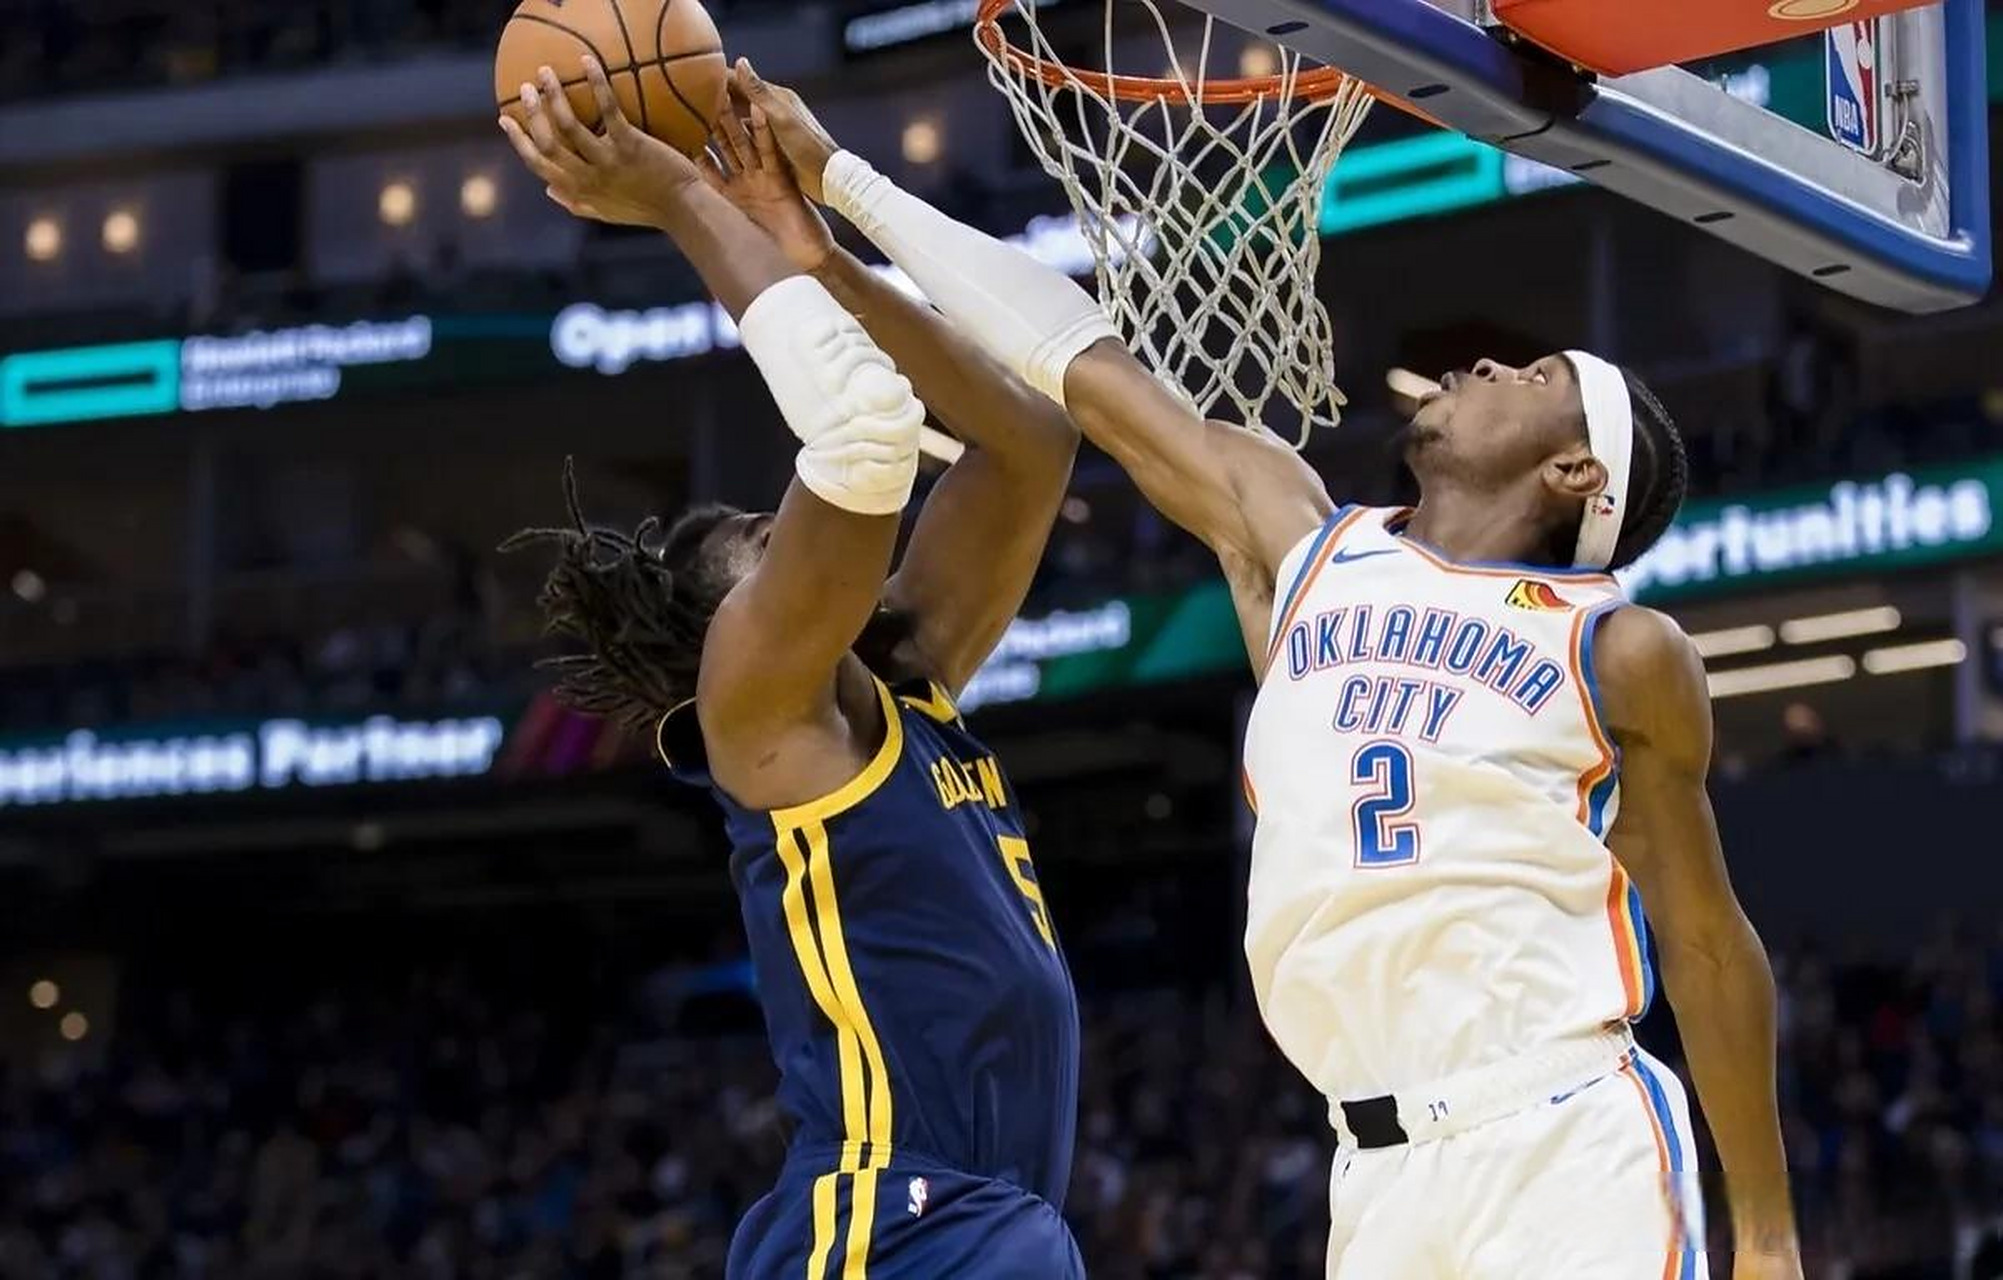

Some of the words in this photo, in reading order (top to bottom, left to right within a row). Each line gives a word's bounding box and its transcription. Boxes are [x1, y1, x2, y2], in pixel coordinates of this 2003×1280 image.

[1834, 94, 1860, 138] NBA
[1286, 604, 1565, 716] OKLAHOMA
[1332, 673, 1465, 743] CITY
[1350, 738, 1421, 869] 2
